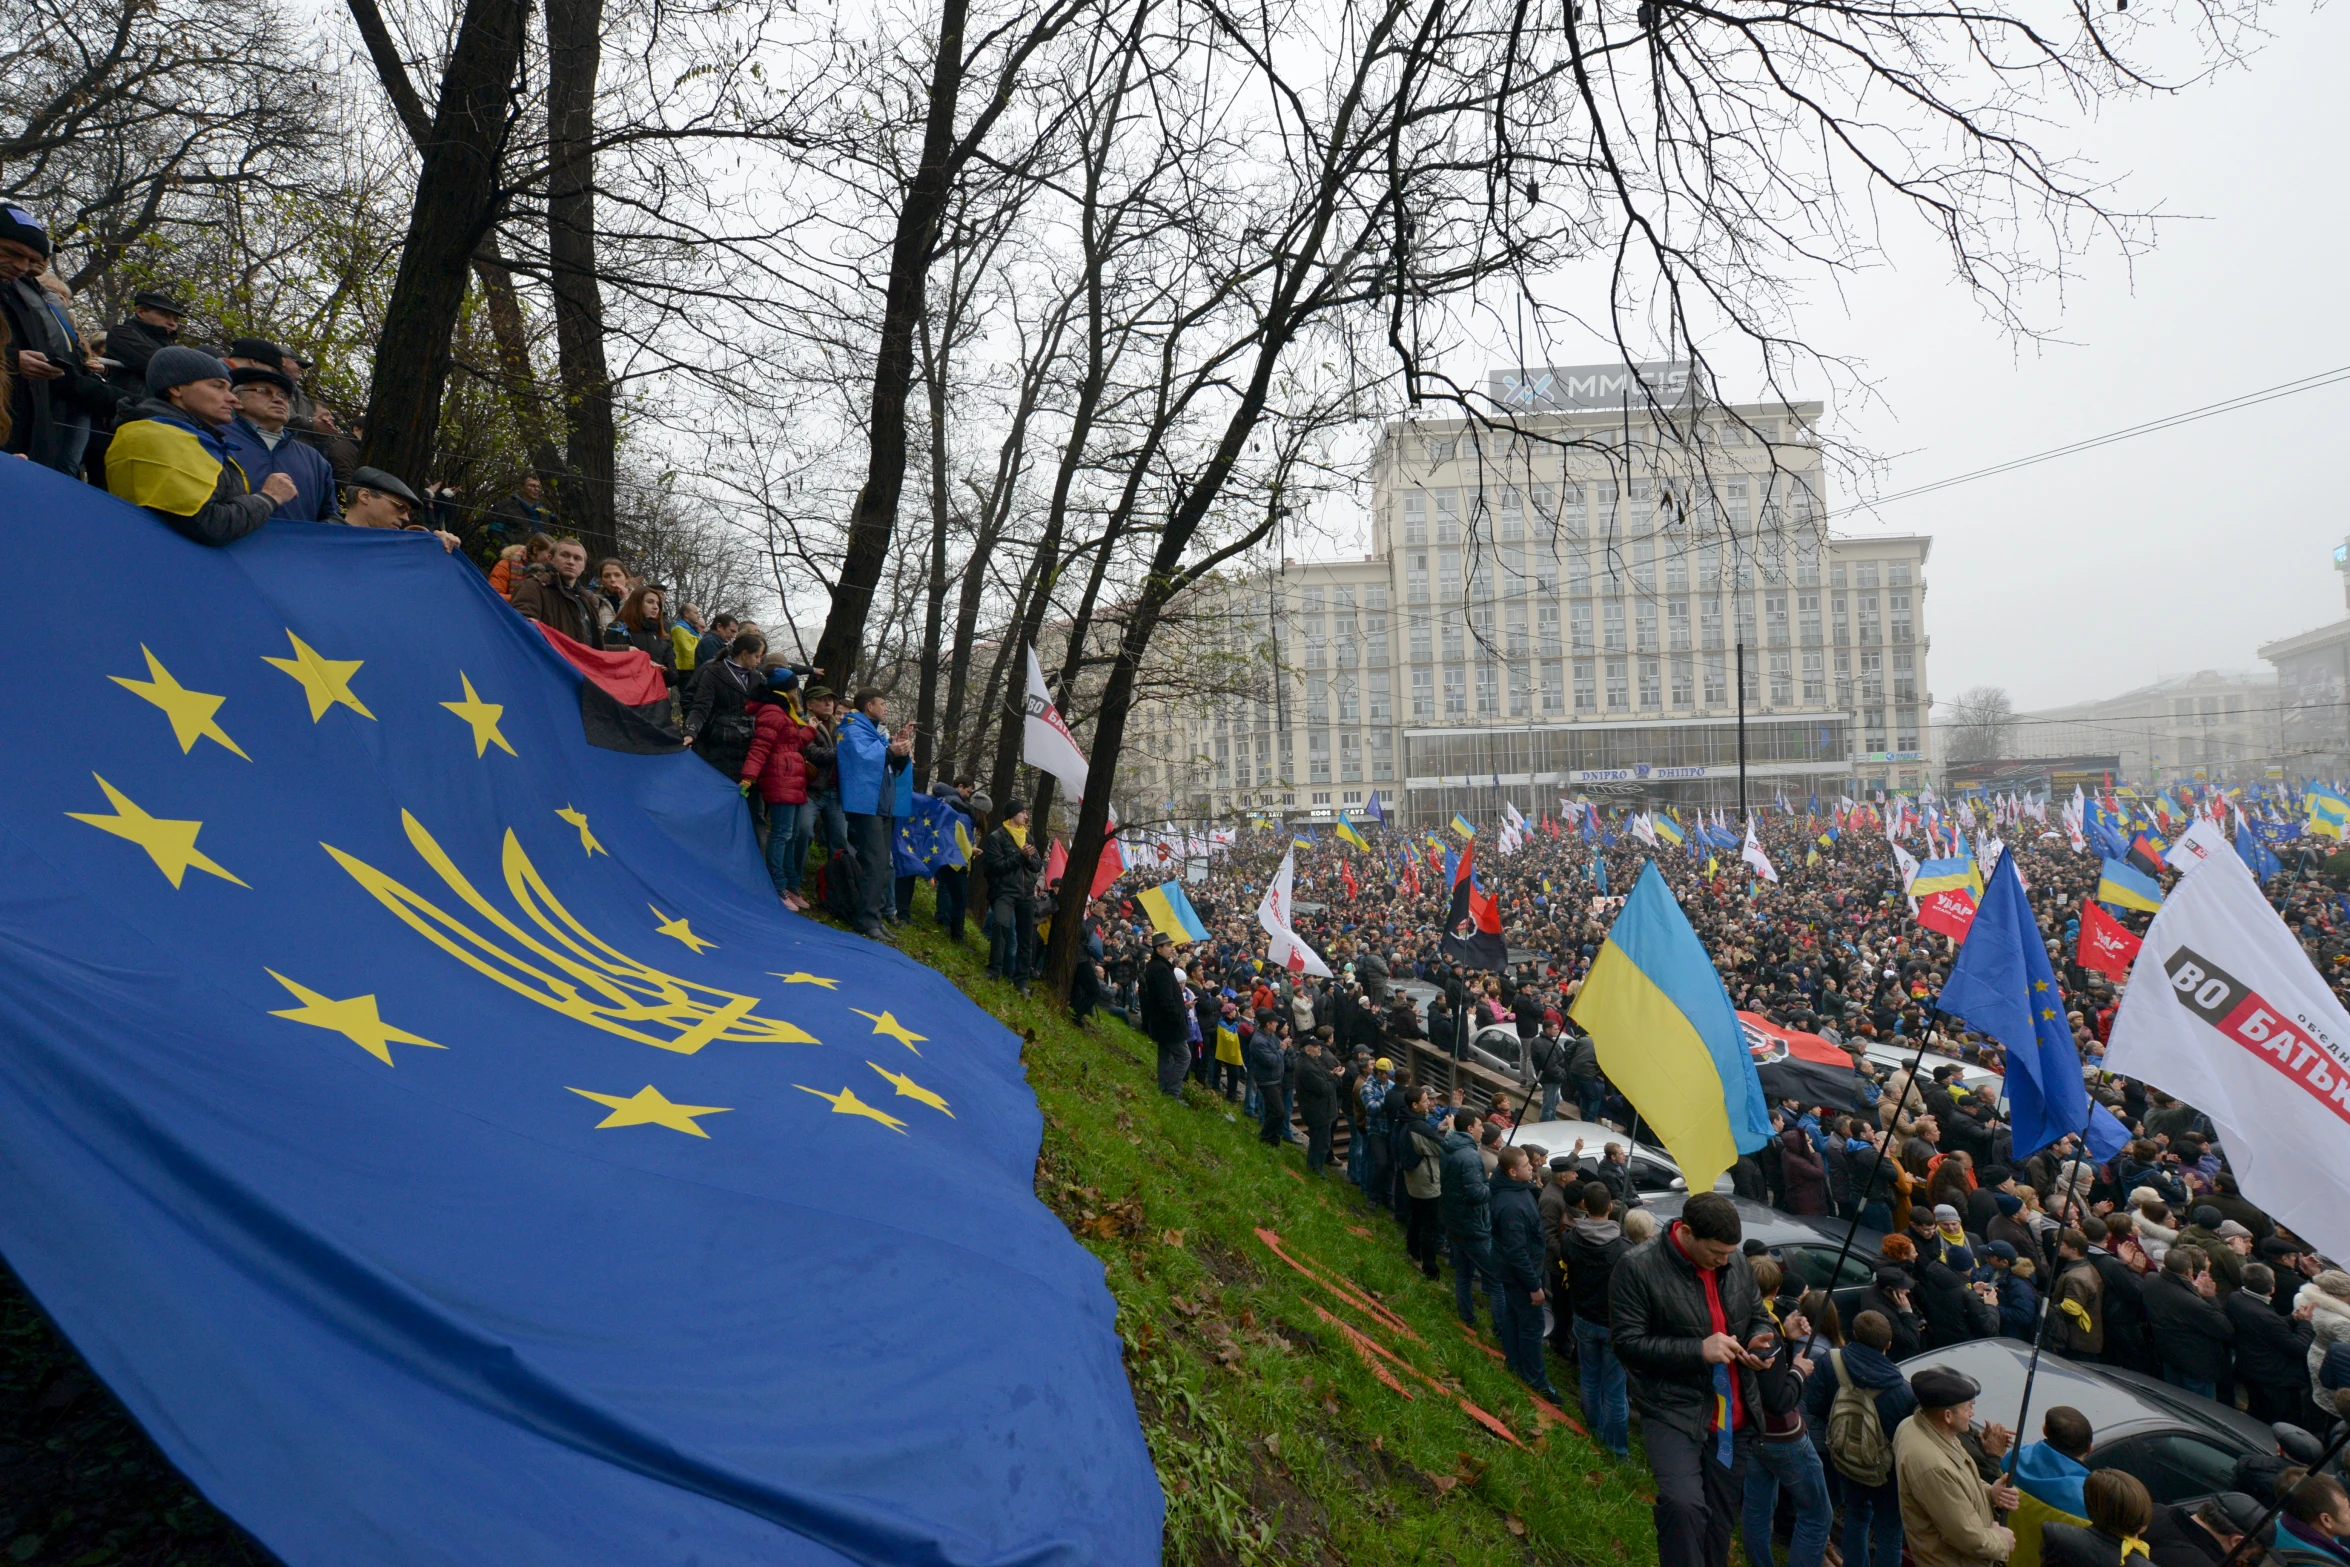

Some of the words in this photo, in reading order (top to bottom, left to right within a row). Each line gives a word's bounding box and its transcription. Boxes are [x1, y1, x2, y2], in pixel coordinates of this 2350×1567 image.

[1568, 371, 1690, 398] MMCIS
[1557, 456, 1655, 472] PANORMA
[1027, 698, 1045, 714] ВО
[1582, 770, 1627, 781] DNIPRO
[1937, 893, 1974, 916] УДАР
[2170, 960, 2231, 1010] ВО
[2297, 1013, 2350, 1068] ОБ'ЄДН
